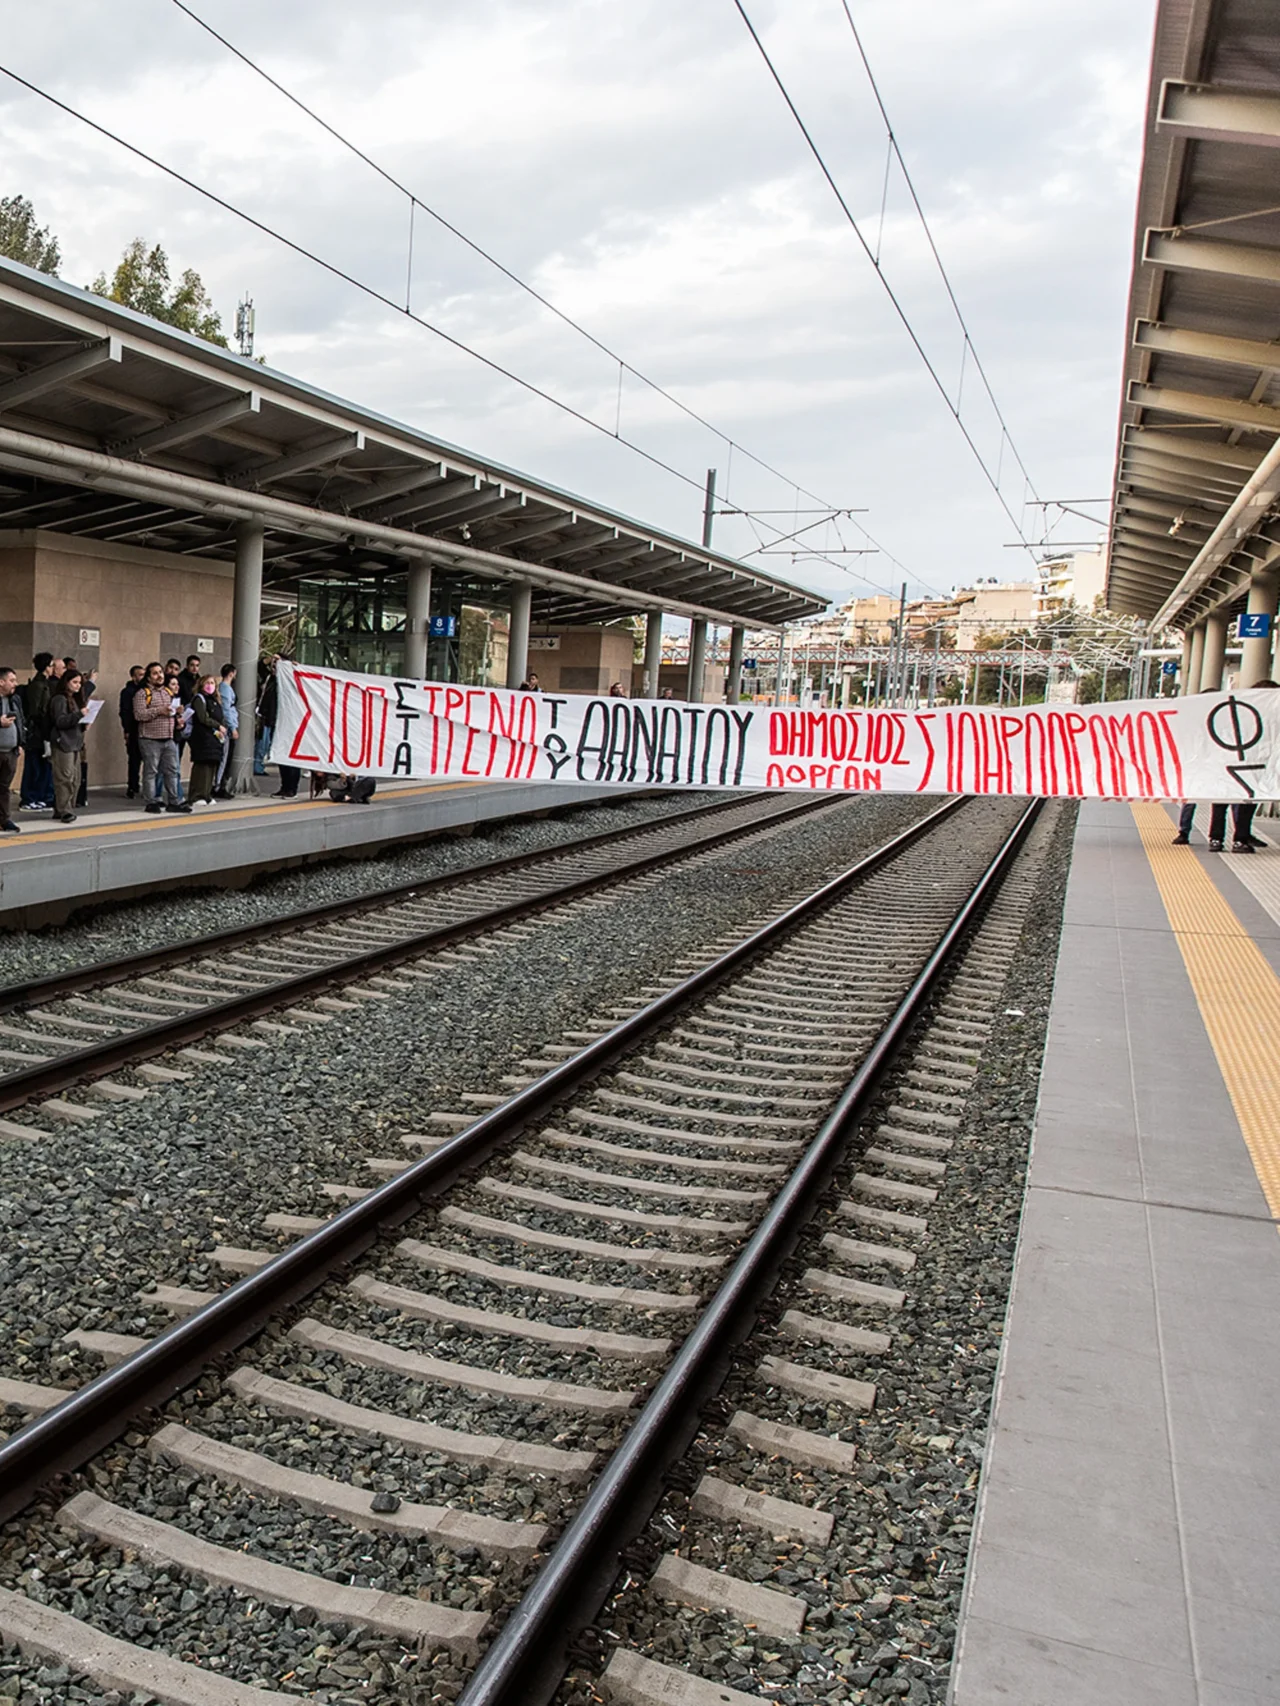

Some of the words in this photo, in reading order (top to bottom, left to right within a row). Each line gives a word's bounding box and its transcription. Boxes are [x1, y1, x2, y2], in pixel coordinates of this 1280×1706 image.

[436, 618, 443, 627] 8
[1250, 616, 1260, 627] 7
[289, 670, 388, 768] ΣΤΟΠ
[392, 682, 420, 775] ΣΤΑ
[423, 686, 538, 779] ΤΡΕΝΑ
[542, 698, 571, 780] ΤΟΥ
[769, 711, 910, 765] ΔΗΜΟΣΙΟΣ
